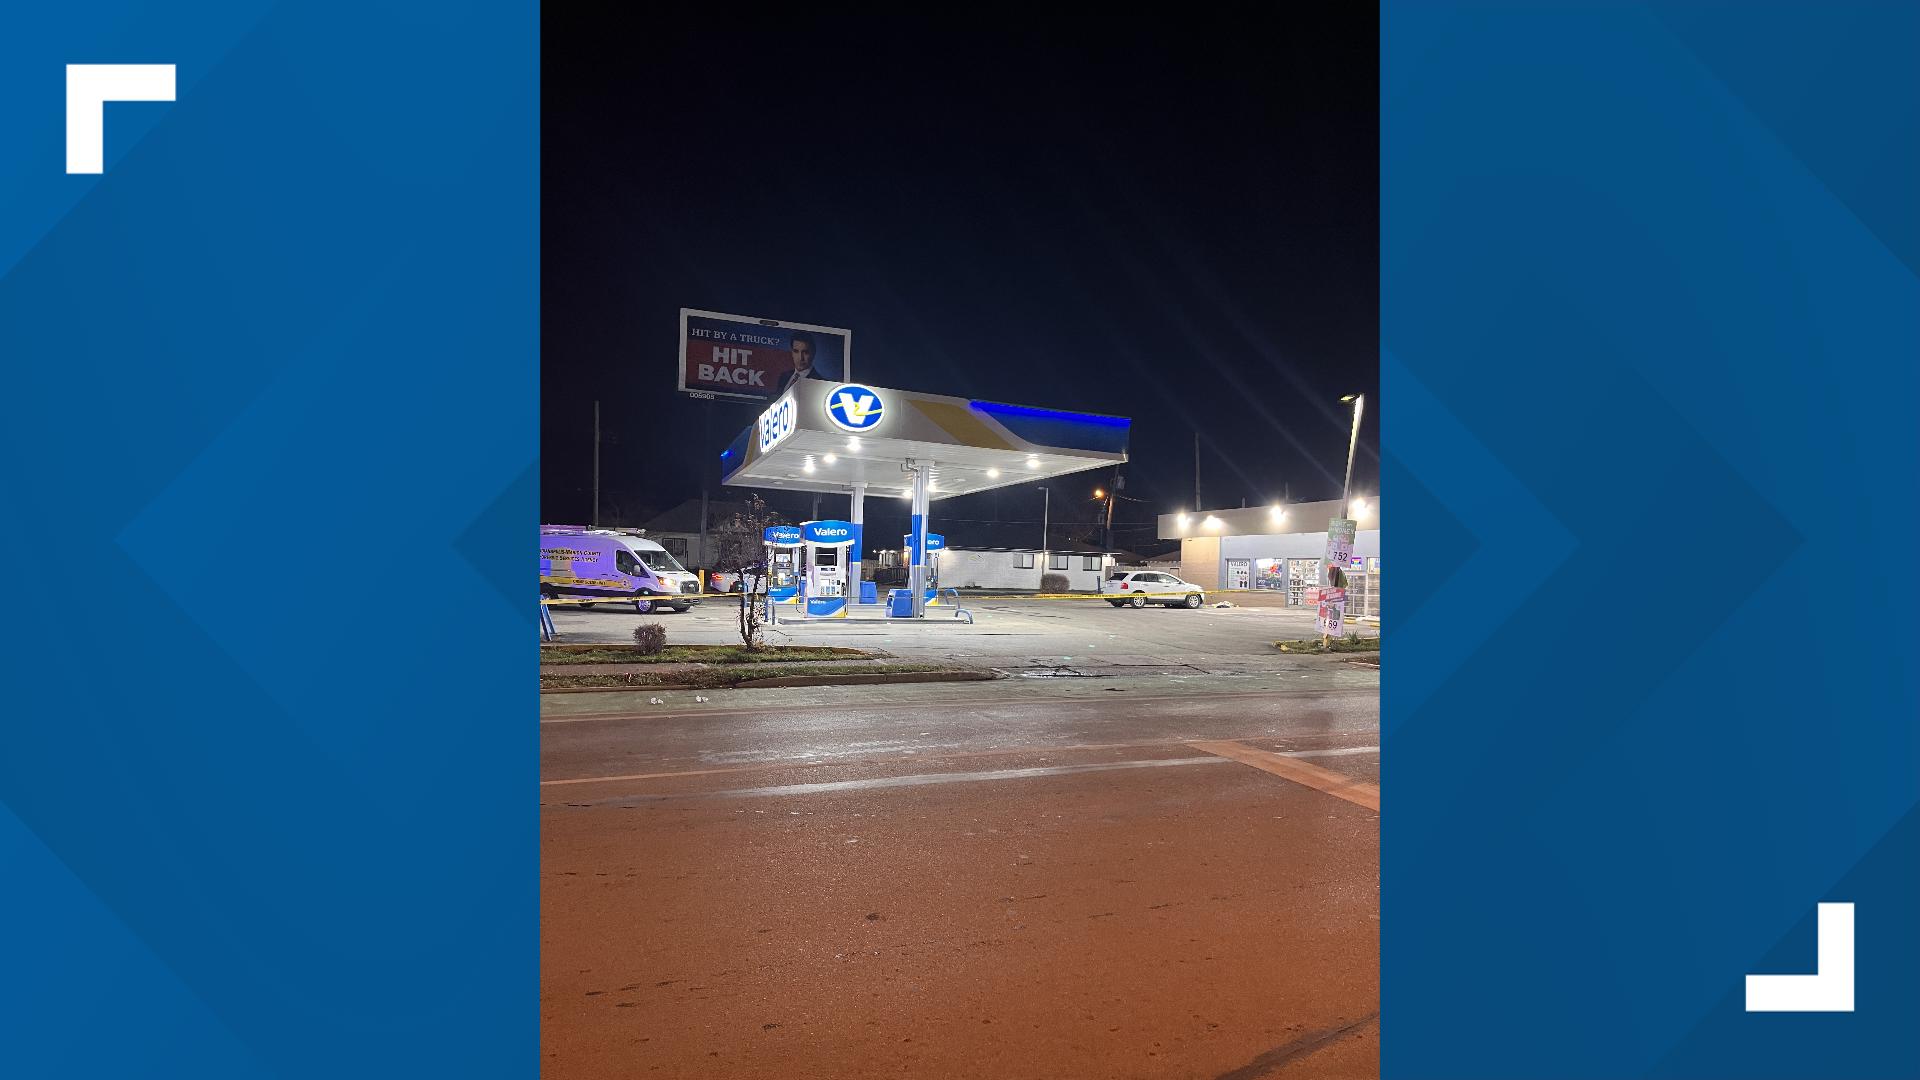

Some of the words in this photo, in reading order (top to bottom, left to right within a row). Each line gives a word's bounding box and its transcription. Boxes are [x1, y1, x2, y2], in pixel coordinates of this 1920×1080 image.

[691, 328, 711, 338] HIT
[713, 330, 727, 340] BY
[730, 333, 738, 341] A
[739, 333, 780, 346] TRUCK?
[712, 346, 753, 366] HIT
[698, 363, 765, 387] BACK
[759, 400, 789, 448] Valero
[772, 531, 800, 539] Valero
[813, 527, 848, 537] Valero
[1333, 551, 1348, 562] 752
